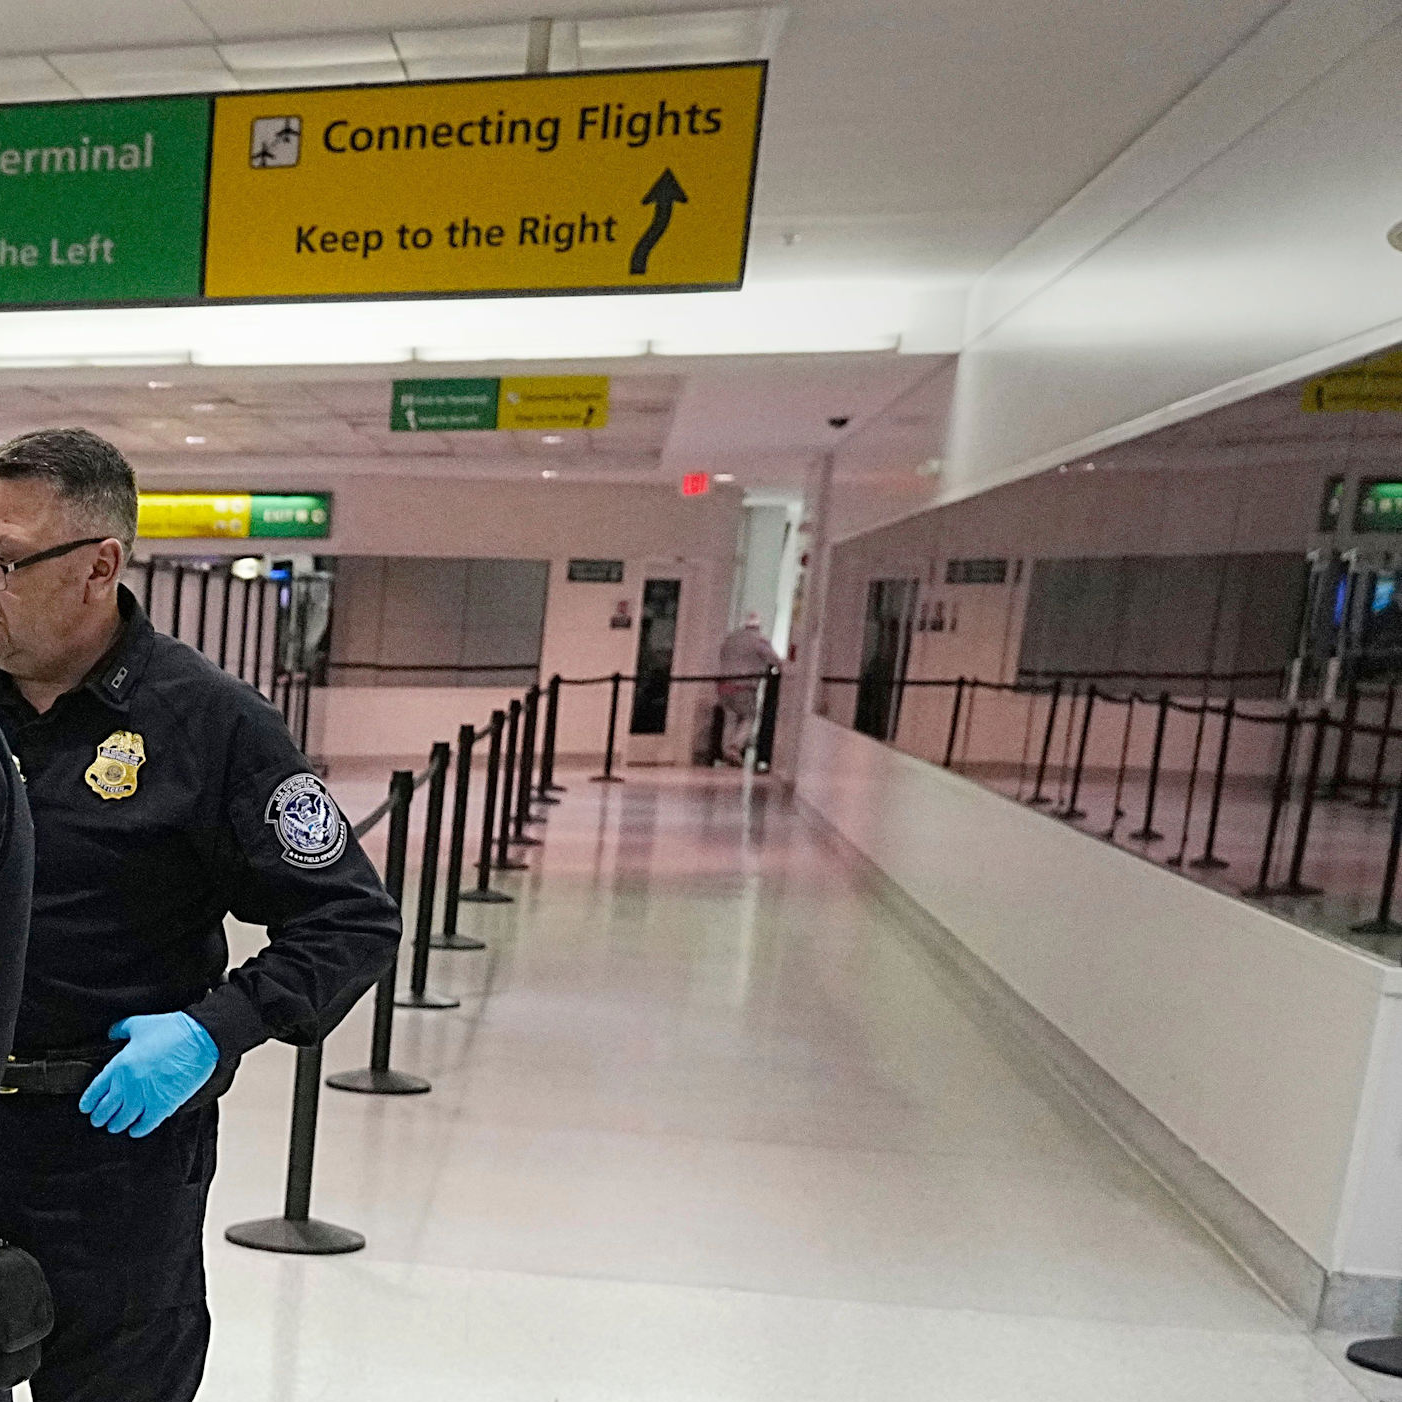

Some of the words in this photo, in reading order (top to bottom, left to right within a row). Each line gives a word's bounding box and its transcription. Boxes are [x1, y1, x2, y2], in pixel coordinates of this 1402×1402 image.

[322, 109, 563, 155] Connecting
[576, 100, 724, 149] Flights
[50, 234, 115, 267] Left
[295, 224, 384, 259] Keep
[398, 223, 434, 252] to
[446, 217, 506, 248] the
[518, 213, 619, 254] Right
